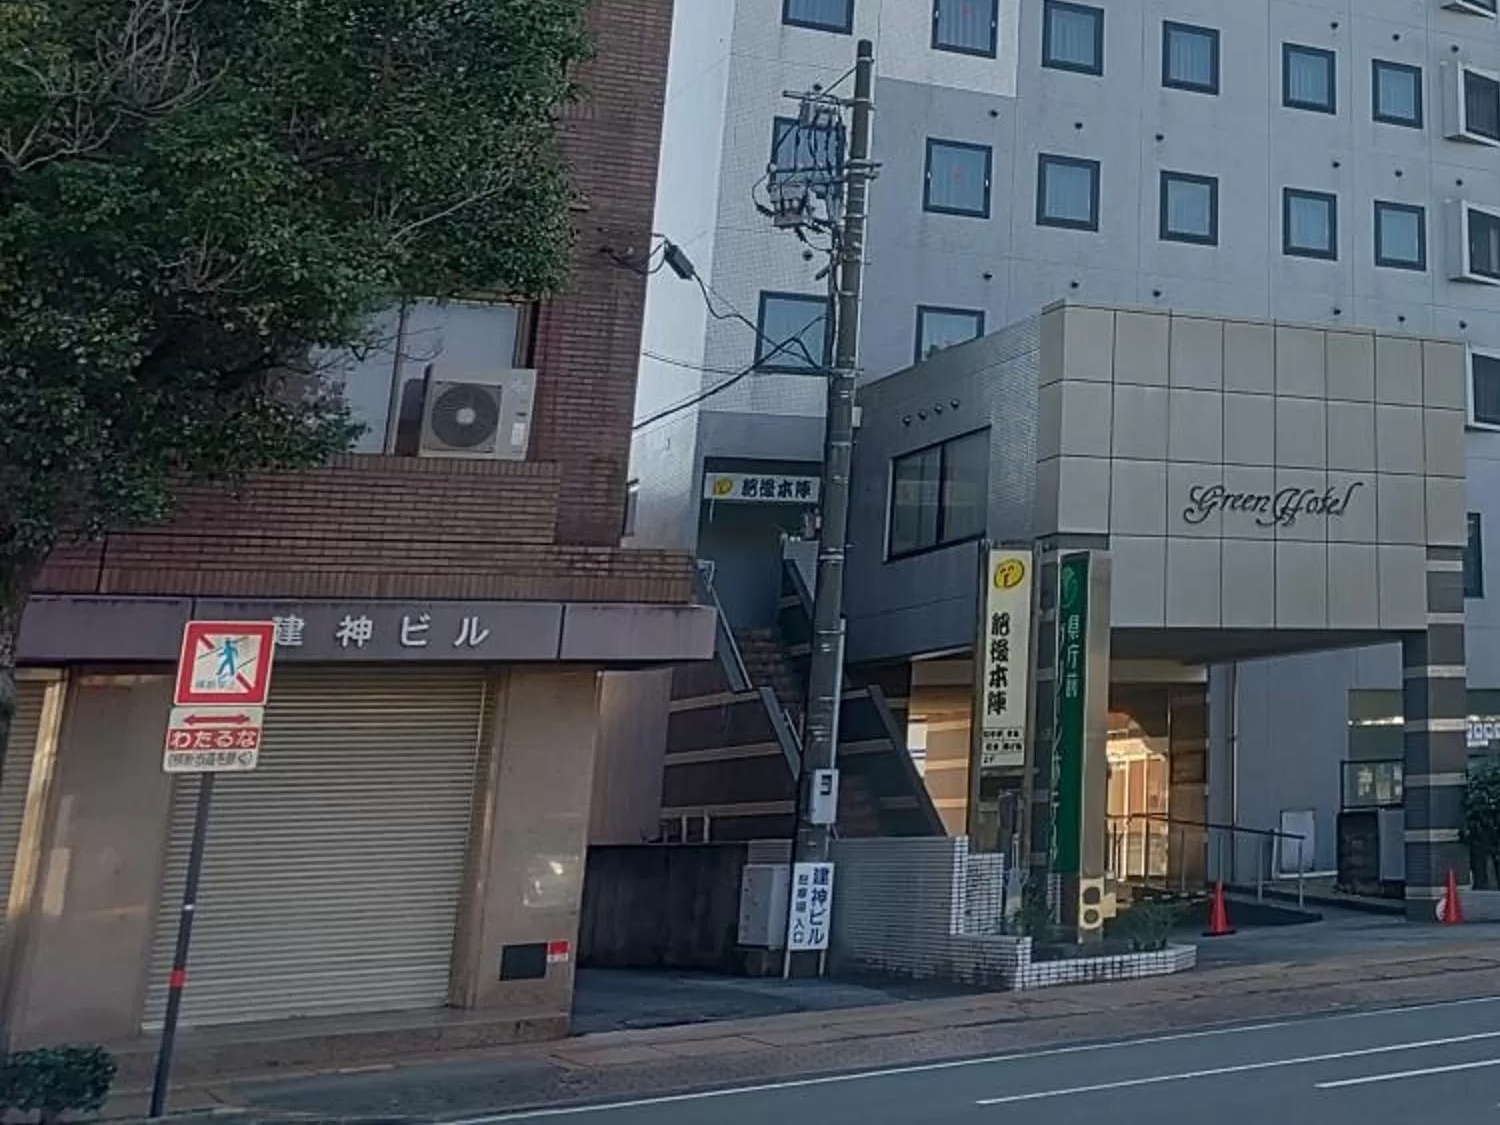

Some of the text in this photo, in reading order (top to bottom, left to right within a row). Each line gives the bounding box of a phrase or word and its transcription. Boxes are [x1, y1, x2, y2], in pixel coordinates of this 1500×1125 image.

[1183, 481, 1364, 527] Green Hotel
[273, 615, 490, 648] 建神ビル
[1064, 613, 1081, 698] 県庁前
[170, 729, 257, 749] わたるな
[807, 866, 830, 946] 建神ビル
